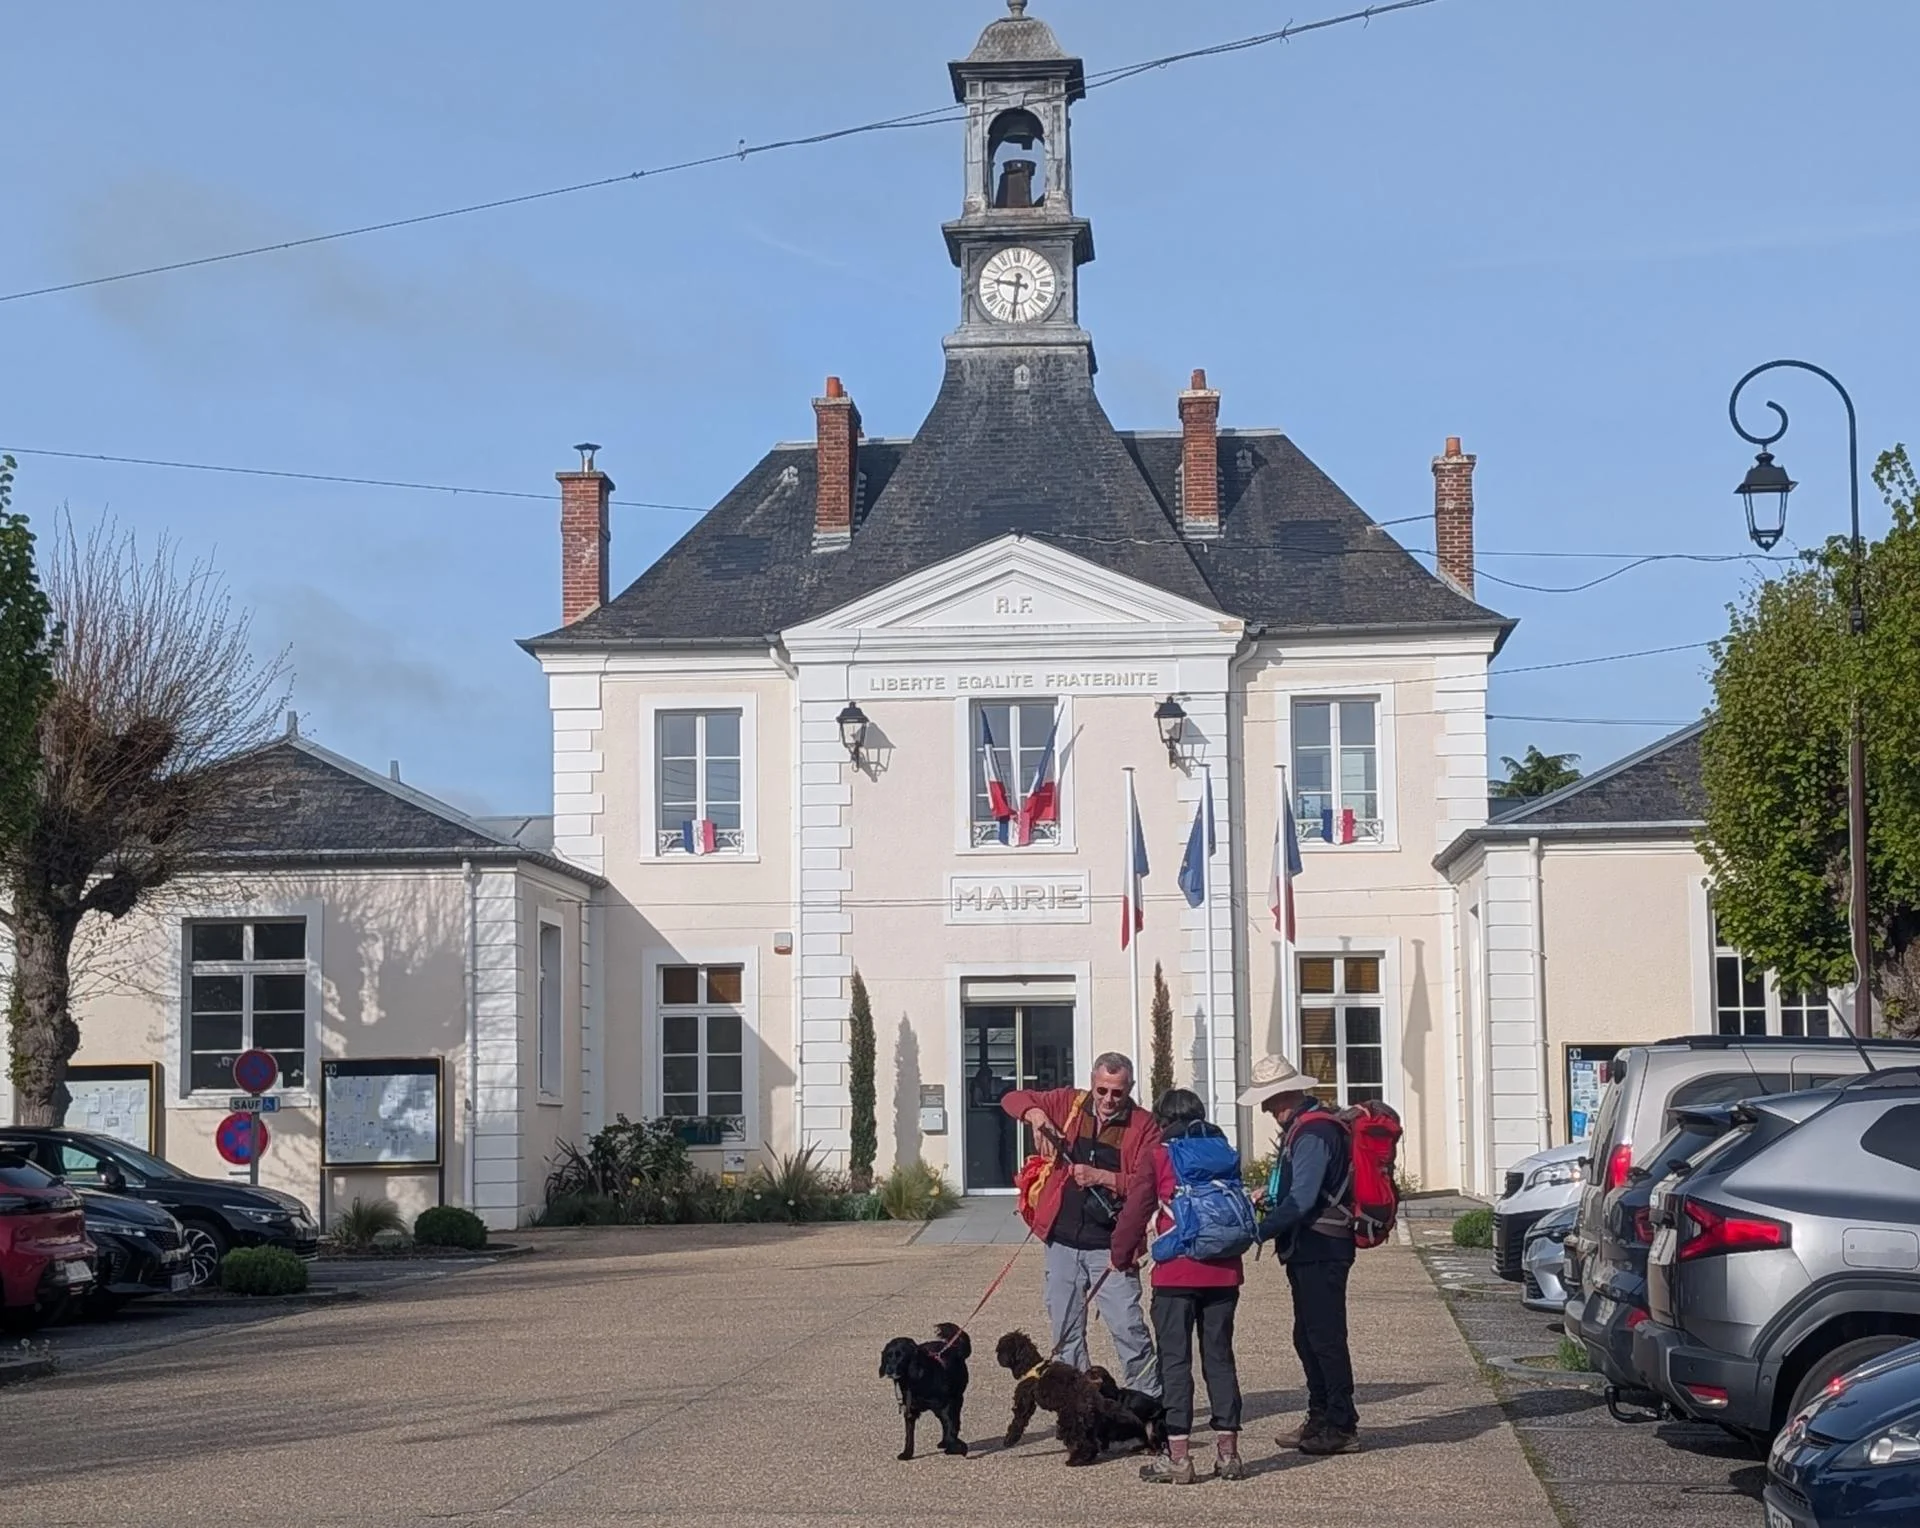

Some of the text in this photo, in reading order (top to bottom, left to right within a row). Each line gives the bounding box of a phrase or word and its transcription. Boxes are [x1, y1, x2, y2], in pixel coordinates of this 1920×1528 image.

[869, 672, 1159, 691] LIBERTE EGALITE FRATERNITE
[954, 885, 1083, 911] MAIRIE
[233, 1099, 262, 1110] SAUF
